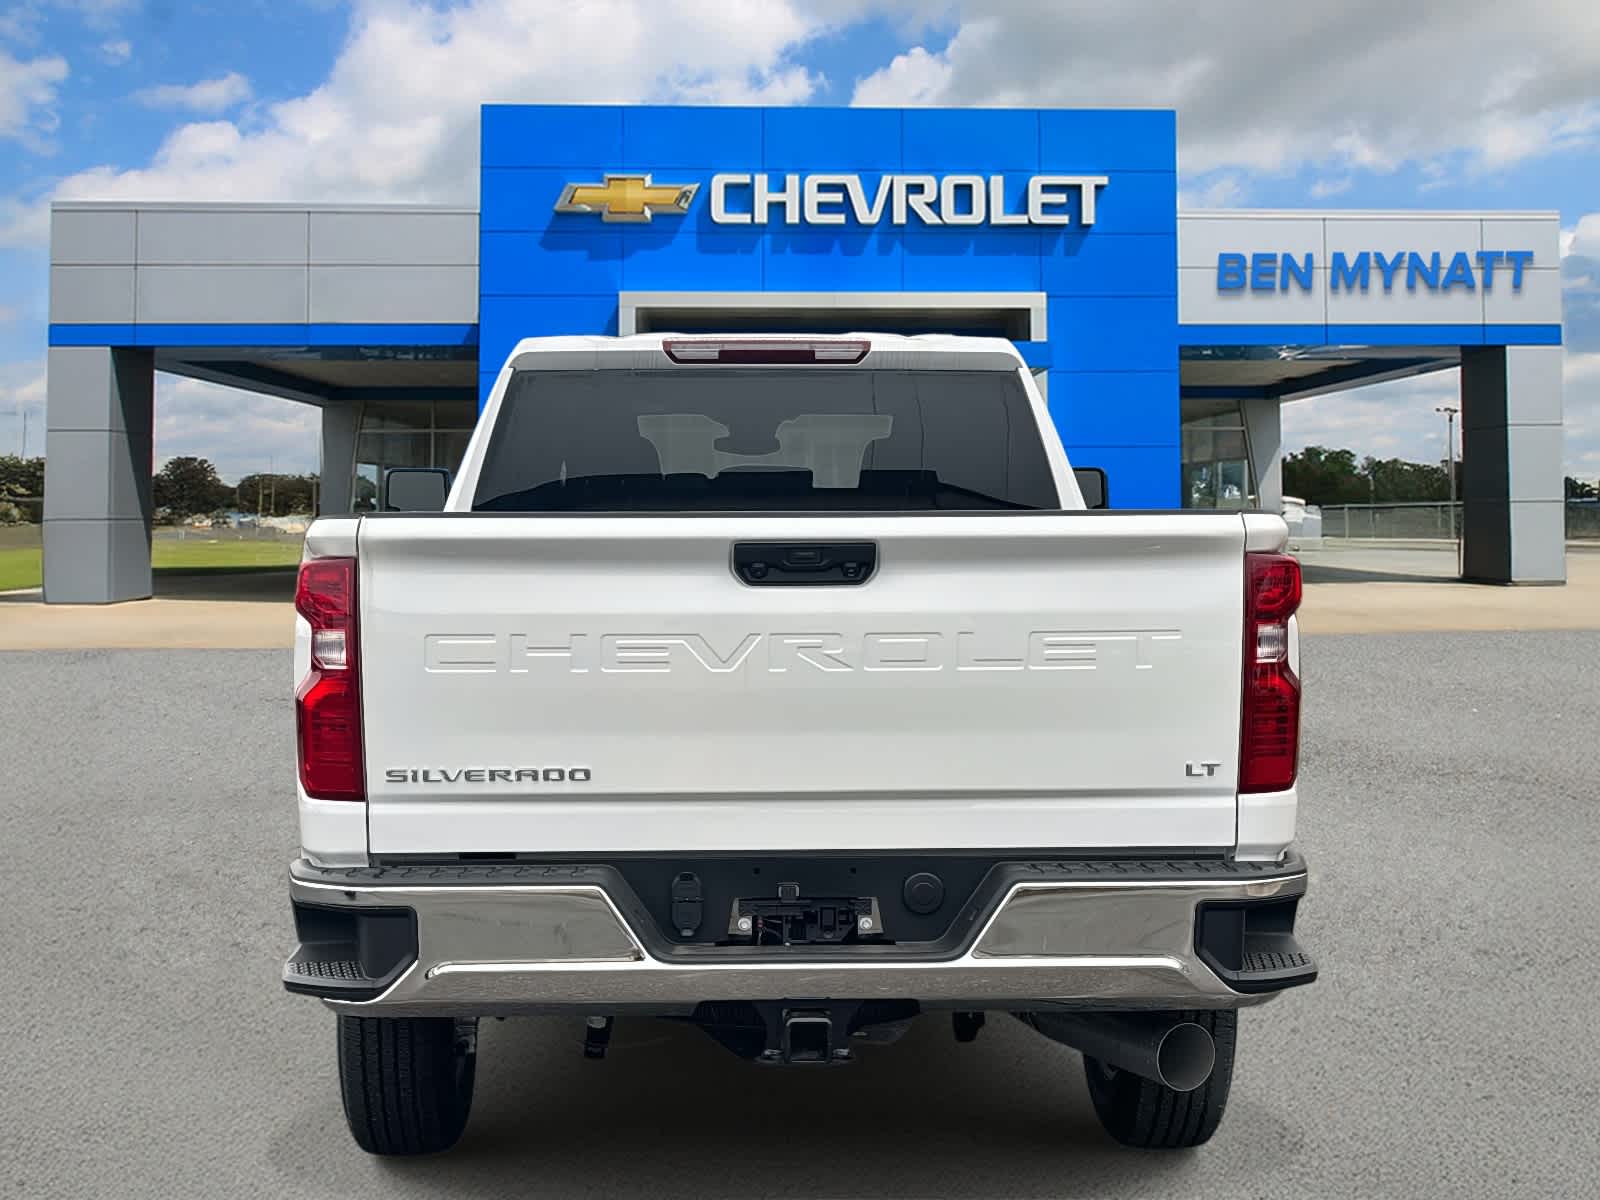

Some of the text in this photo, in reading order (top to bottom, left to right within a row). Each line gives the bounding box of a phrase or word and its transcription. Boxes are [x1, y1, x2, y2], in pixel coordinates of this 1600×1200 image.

[710, 173, 1109, 226] CHEVROLET
[1216, 250, 1534, 291] BEN MYNATT
[423, 630, 1182, 674] CHEVROLET
[385, 767, 592, 784] SILVERADO
[1185, 762, 1221, 778] LT
